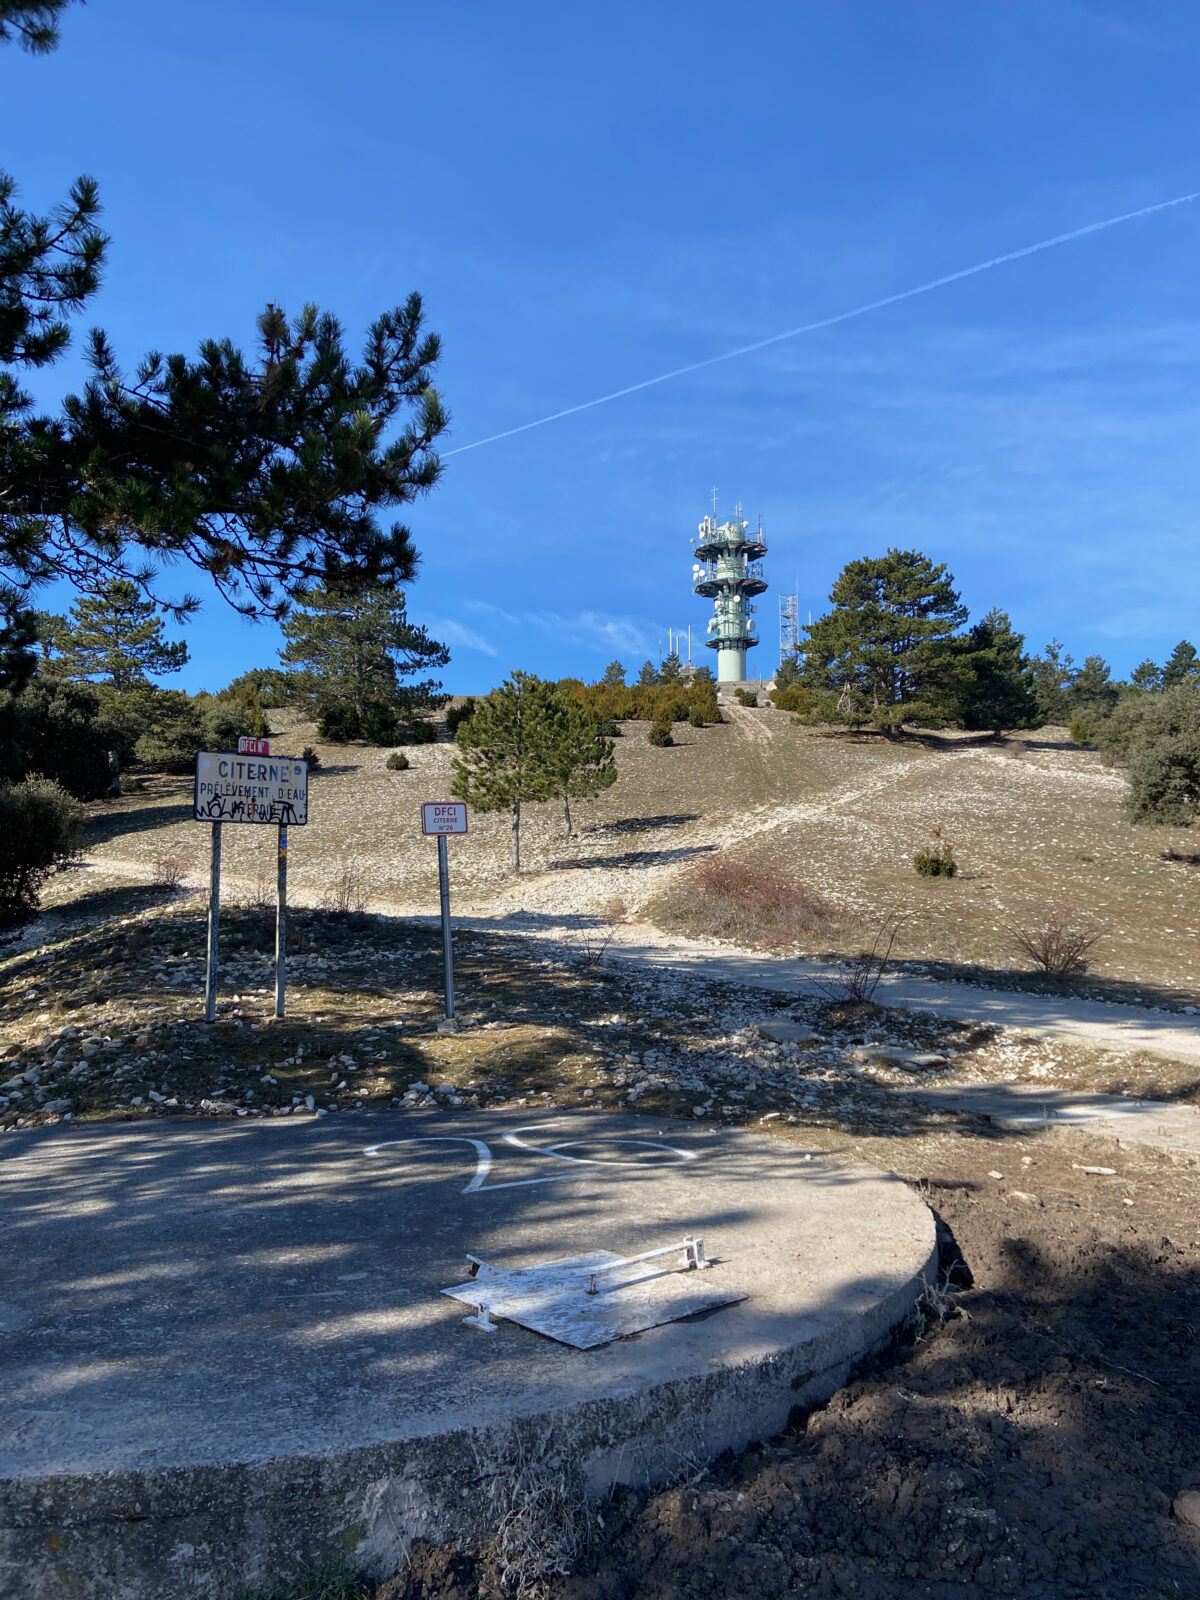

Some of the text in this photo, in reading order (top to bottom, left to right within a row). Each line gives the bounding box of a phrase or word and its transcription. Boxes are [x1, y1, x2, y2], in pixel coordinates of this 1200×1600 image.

[241, 740, 256, 752] DFCI
[218, 760, 289, 783] CITERNE
[278, 787, 305, 801] D'EAU
[434, 806, 456, 816] DFCI
[363, 1123, 698, 1194] 26
